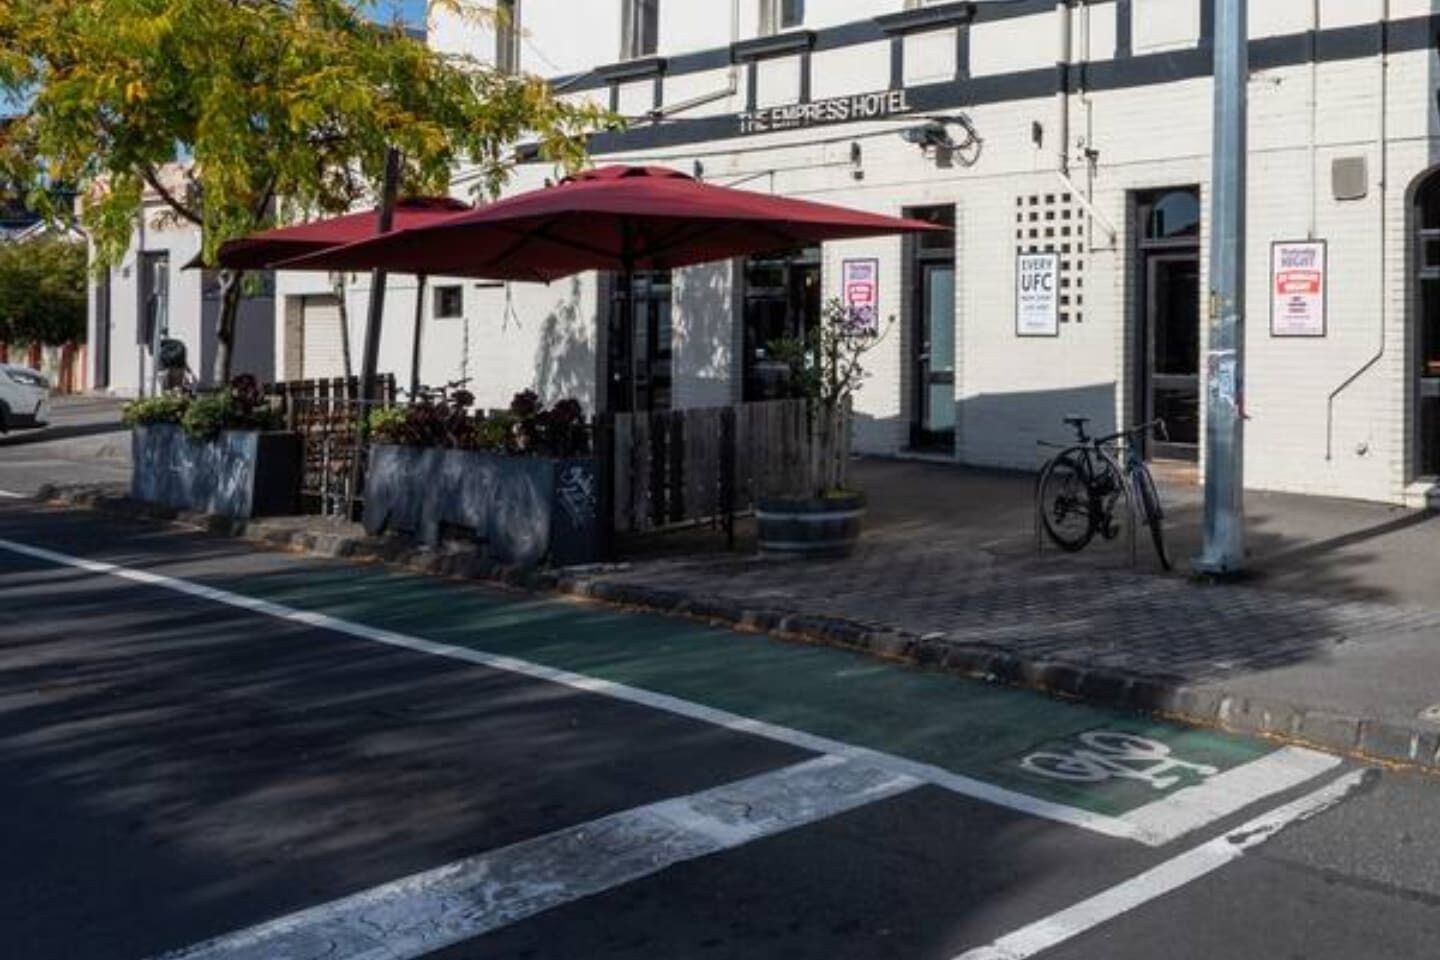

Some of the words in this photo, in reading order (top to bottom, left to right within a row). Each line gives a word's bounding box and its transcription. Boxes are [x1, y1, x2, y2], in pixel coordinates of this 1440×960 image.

[738, 111, 769, 134] THE
[771, 97, 849, 130] EMPRESS
[852, 90, 911, 117] HOTEL
[1021, 258, 1053, 271] EVERY
[1021, 272, 1053, 292] UFC
